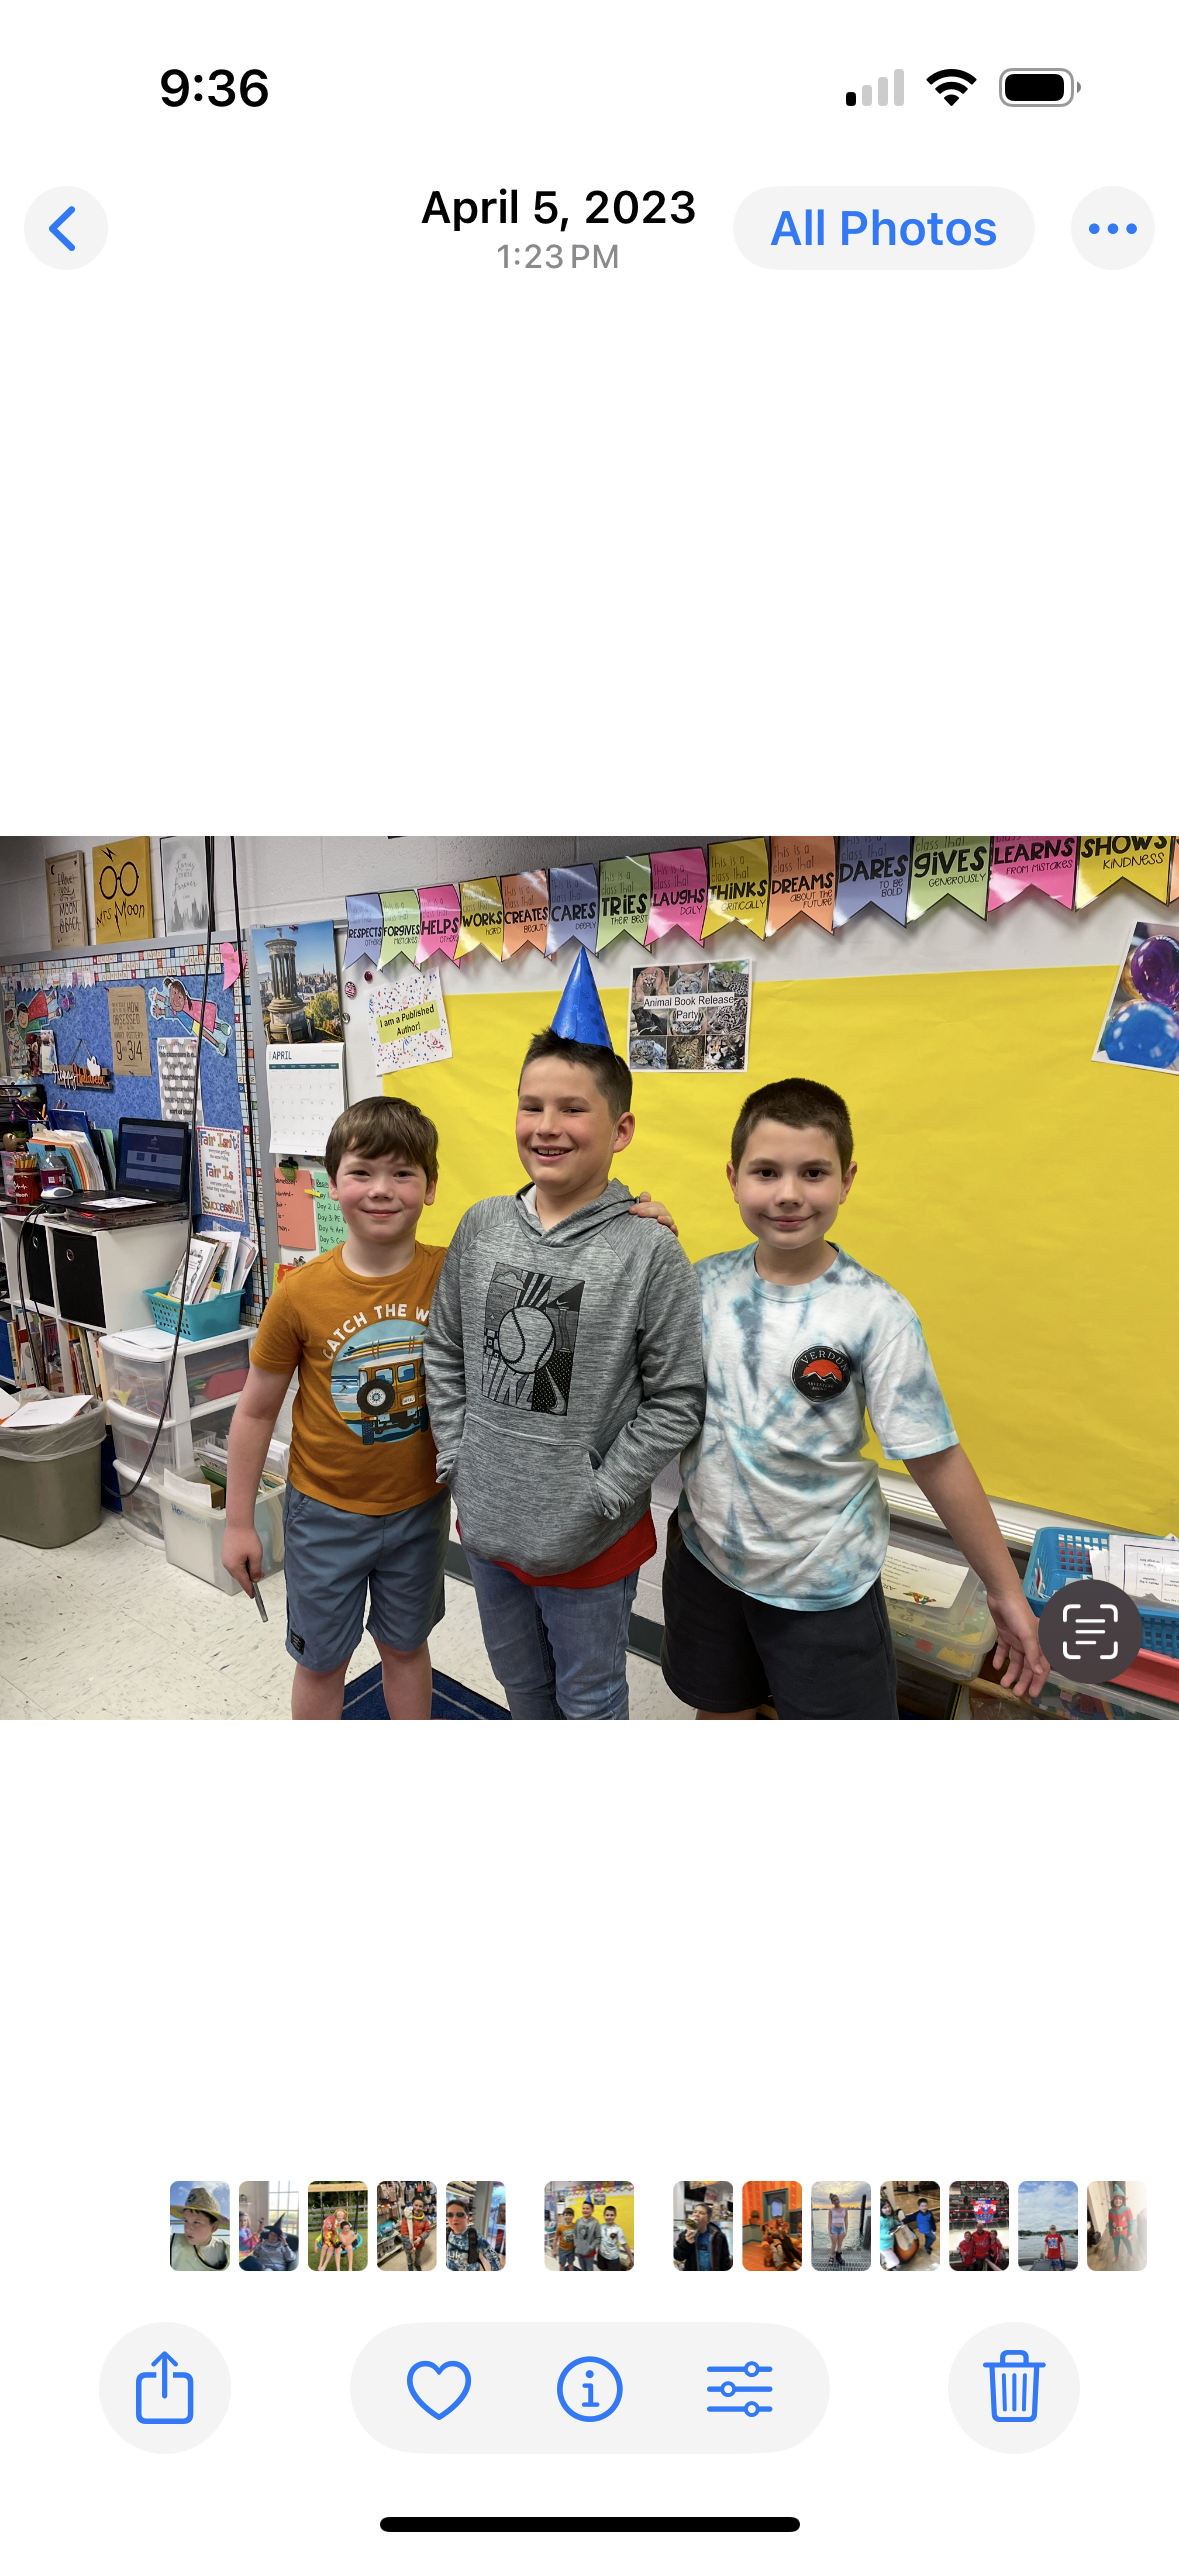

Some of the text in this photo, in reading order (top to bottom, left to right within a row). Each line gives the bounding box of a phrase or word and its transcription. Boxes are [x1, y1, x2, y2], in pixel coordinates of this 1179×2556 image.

[773, 845, 809, 859] This is a
[842, 843, 886, 861] class that
[916, 837, 938, 852] class
[994, 837, 1075, 865] LEARNS
[1081, 836, 1167, 858] SHOWS
[711, 856, 744, 868] This is a
[773, 856, 814, 874] class that
[839, 854, 908, 883] DARES
[602, 871, 614, 882] This
[653, 864, 668, 876] This
[711, 866, 749, 882] class that
[1006, 866, 1029, 875] FROM
[601, 881, 634, 895] class that
[654, 873, 688, 889] class that
[772, 872, 834, 894] DREAMS
[881, 888, 902, 897] BOLD
[115, 898, 145, 937] Moon
[462, 909, 502, 927] WORKS
[504, 907, 549, 925] CREATES
[551, 902, 596, 922] CARES
[348, 927, 382, 938] RESPECTS
[421, 917, 459, 935] HELPS
[127, 1002, 139, 1012] HOW
[644, 995, 734, 1007] Animal Book Release
[113, 1014, 140, 1025] OBSESSED
[384, 1018, 394, 1027] am
[402, 1004, 434, 1021] Published
[677, 1010, 699, 1020] Party
[397, 1022, 420, 1036] Author!
[116, 1040, 122, 1061] 9
[272, 1051, 292, 1060] APRIL
[53, 1063, 105, 1090] Happy Halloween
[200, 1131, 238, 1150] Fair Isn't
[206, 1162, 233, 1181] Fair Is
[317, 1202, 326, 1211] Day
[318, 1213, 327, 1221] Day
[319, 1224, 328, 1232] Day
[320, 1235, 329, 1244] Day
[322, 1312, 368, 1360] CATCH
[374, 1304, 407, 1319] THE
